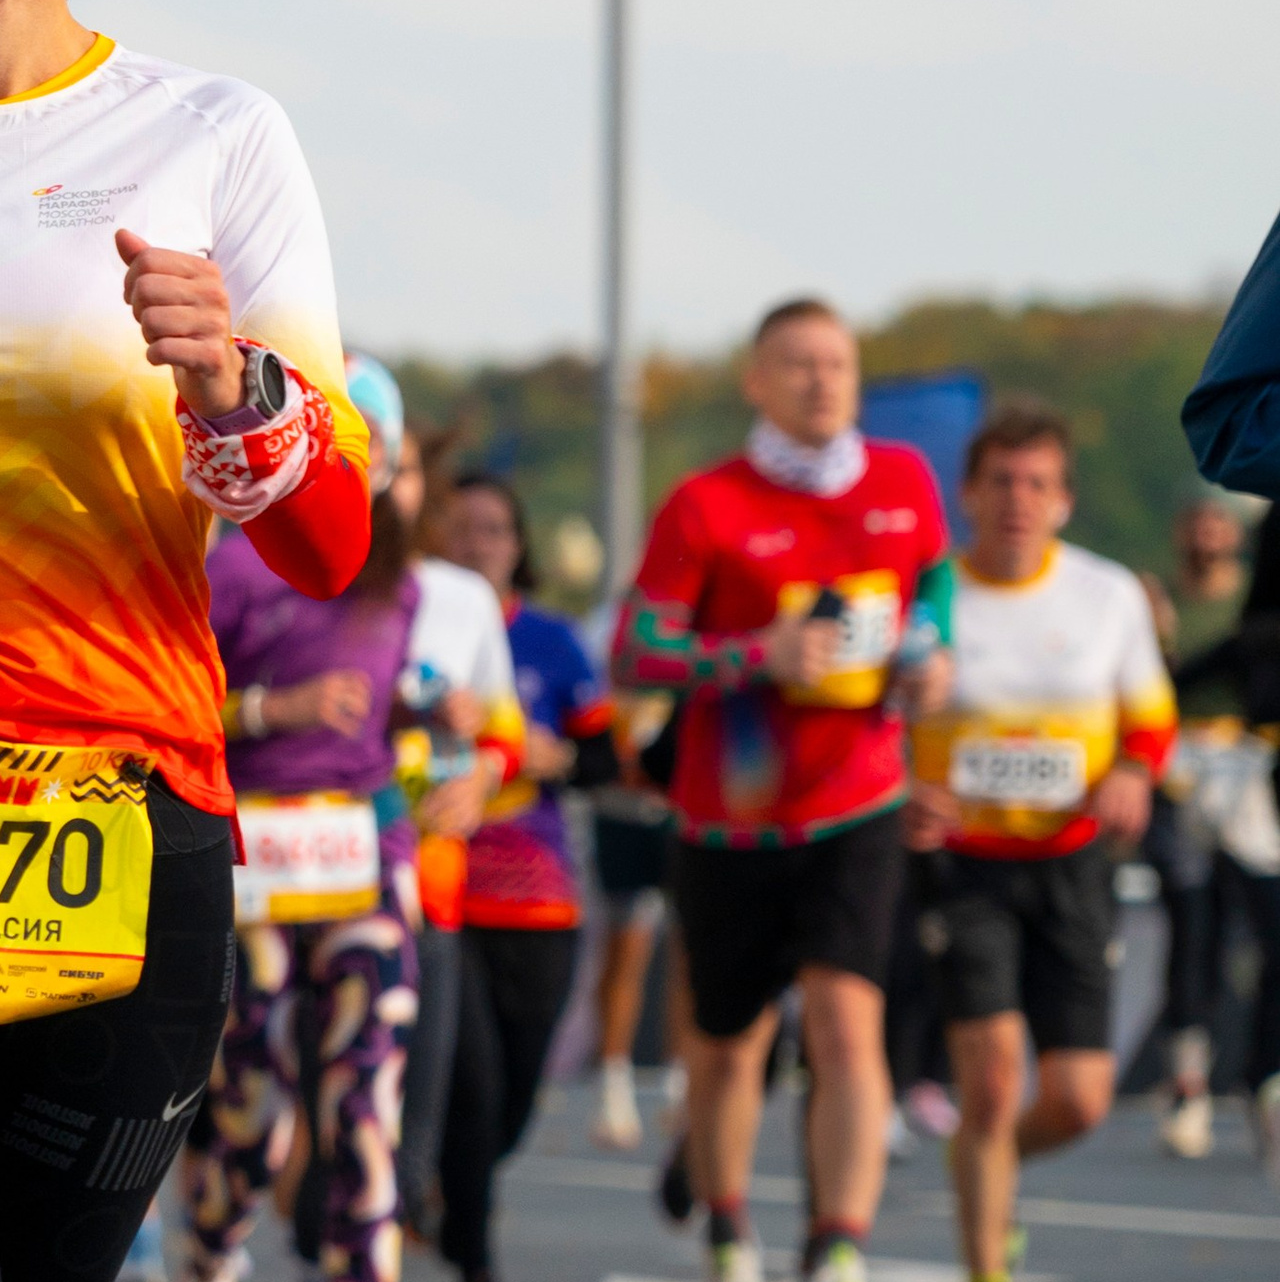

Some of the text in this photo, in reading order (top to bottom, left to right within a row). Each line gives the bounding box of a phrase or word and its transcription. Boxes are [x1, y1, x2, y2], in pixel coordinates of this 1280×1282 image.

[38, 183, 139, 202] МОСКОВСКИЙ
[38, 197, 111, 210] МАРАФОН
[38, 207, 101, 219] MOSCOW
[38, 215, 116, 229] MARATHON
